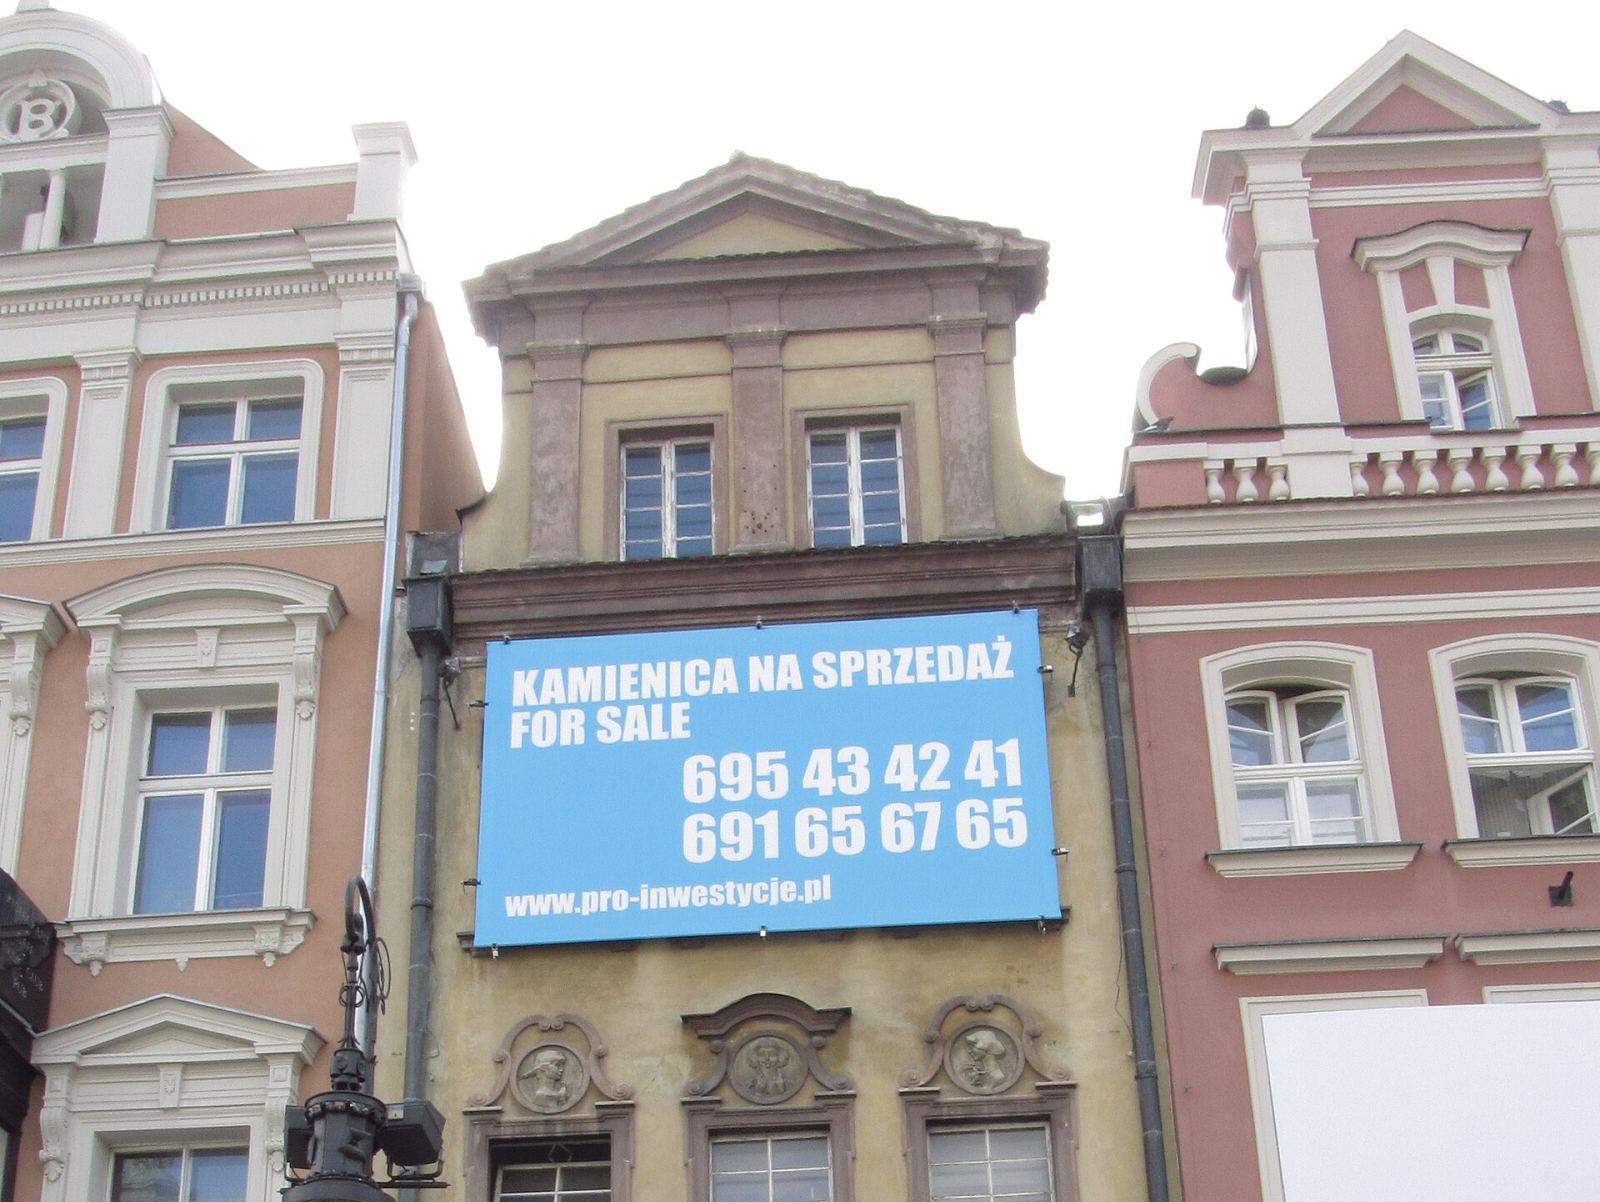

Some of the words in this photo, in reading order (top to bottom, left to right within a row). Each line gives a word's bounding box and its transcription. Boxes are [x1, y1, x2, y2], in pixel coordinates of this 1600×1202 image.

[512, 657, 739, 707] KAMIENICA
[748, 654, 804, 693] NA
[812, 635, 1015, 690] SPRZEDAŻ
[510, 708, 586, 749] FOR
[596, 702, 691, 744] SALE
[683, 750, 789, 804] 695
[802, 746, 871, 797] 43
[884, 741, 951, 793] 42
[964, 738, 1022, 788] 41
[683, 809, 779, 864] 691
[794, 805, 866, 858] 65
[880, 801, 942, 854] 67
[955, 797, 1029, 850] 65
[505, 874, 832, 917] www.pro-inwestycje.pl
